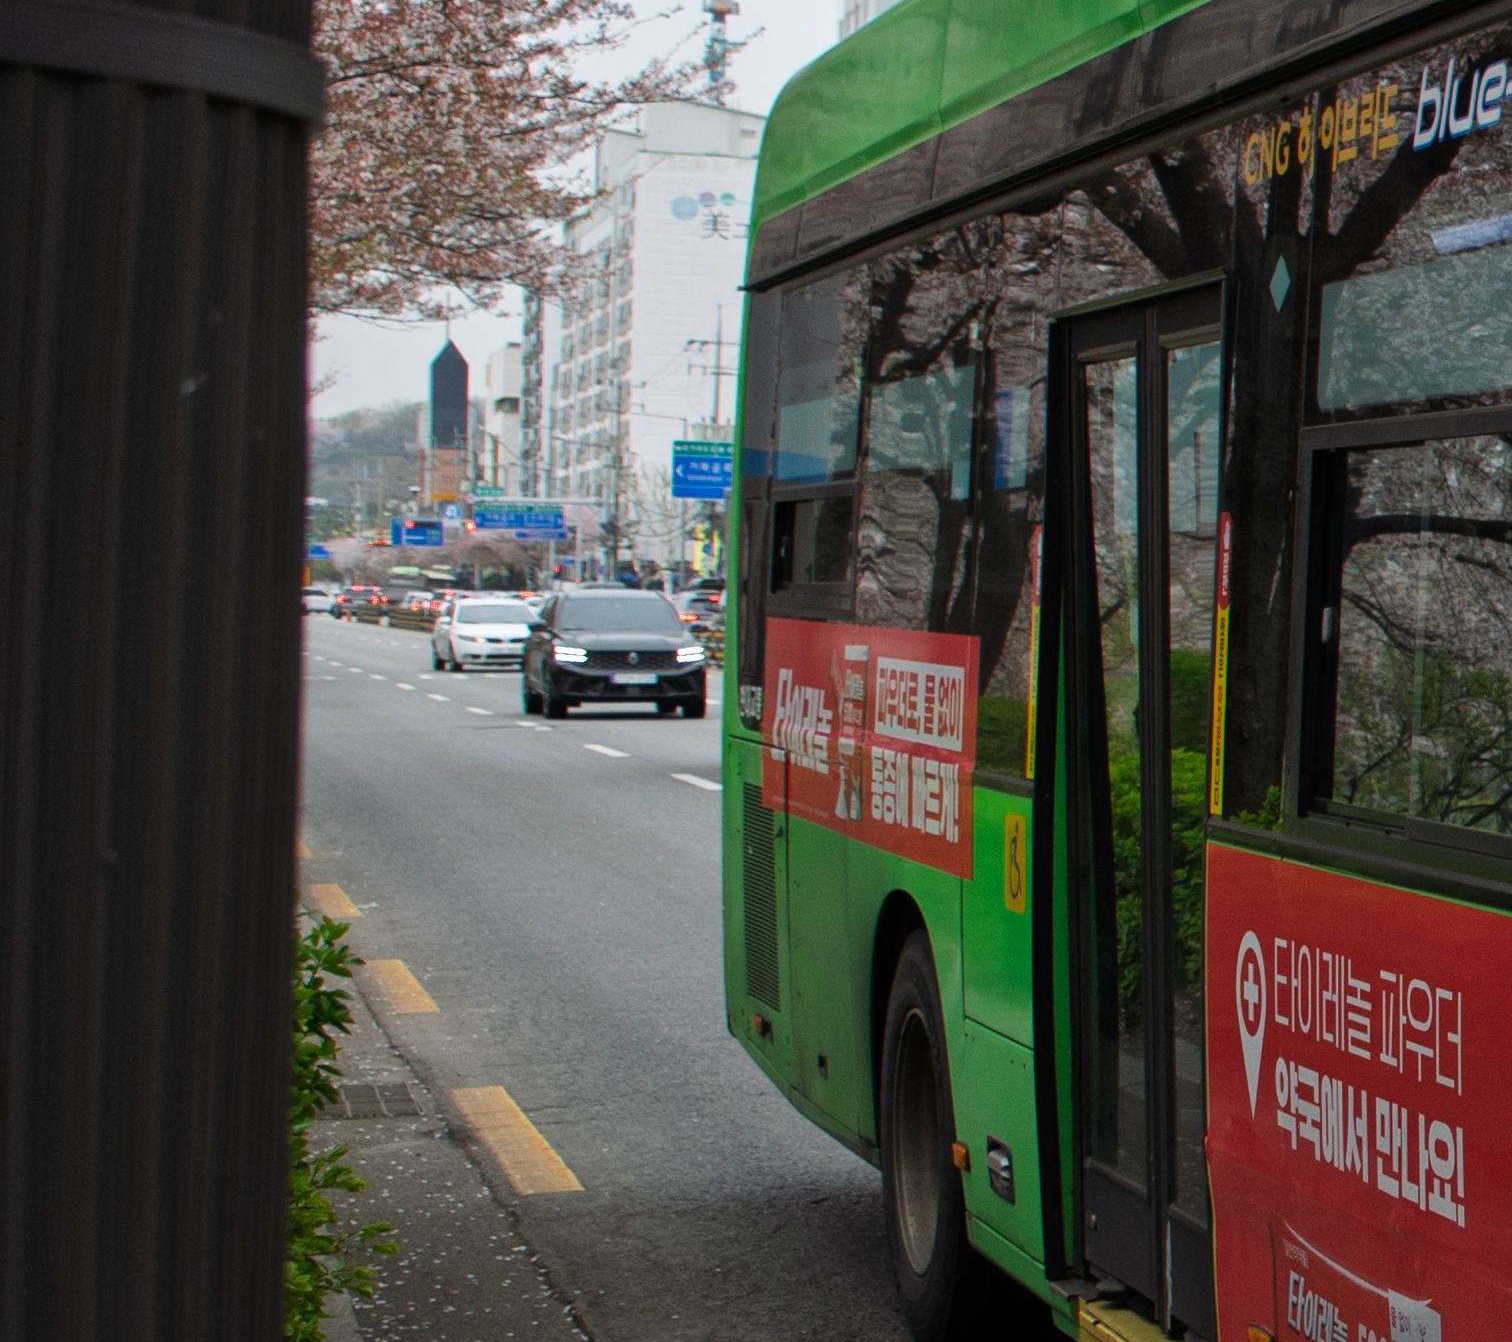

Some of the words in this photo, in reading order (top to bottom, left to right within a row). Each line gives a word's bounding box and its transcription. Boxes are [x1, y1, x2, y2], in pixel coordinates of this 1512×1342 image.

[1244, 121, 1290, 186] CNG
[1297, 85, 1400, 172] 하이브리드
[938, 675, 962, 741] 없이
[1273, 936, 1373, 1062] 타이레놀
[1379, 969, 1464, 1097] 파우더
[1274, 1055, 1370, 1185] 약국에서
[1375, 1100, 1467, 1228] 만나요!
